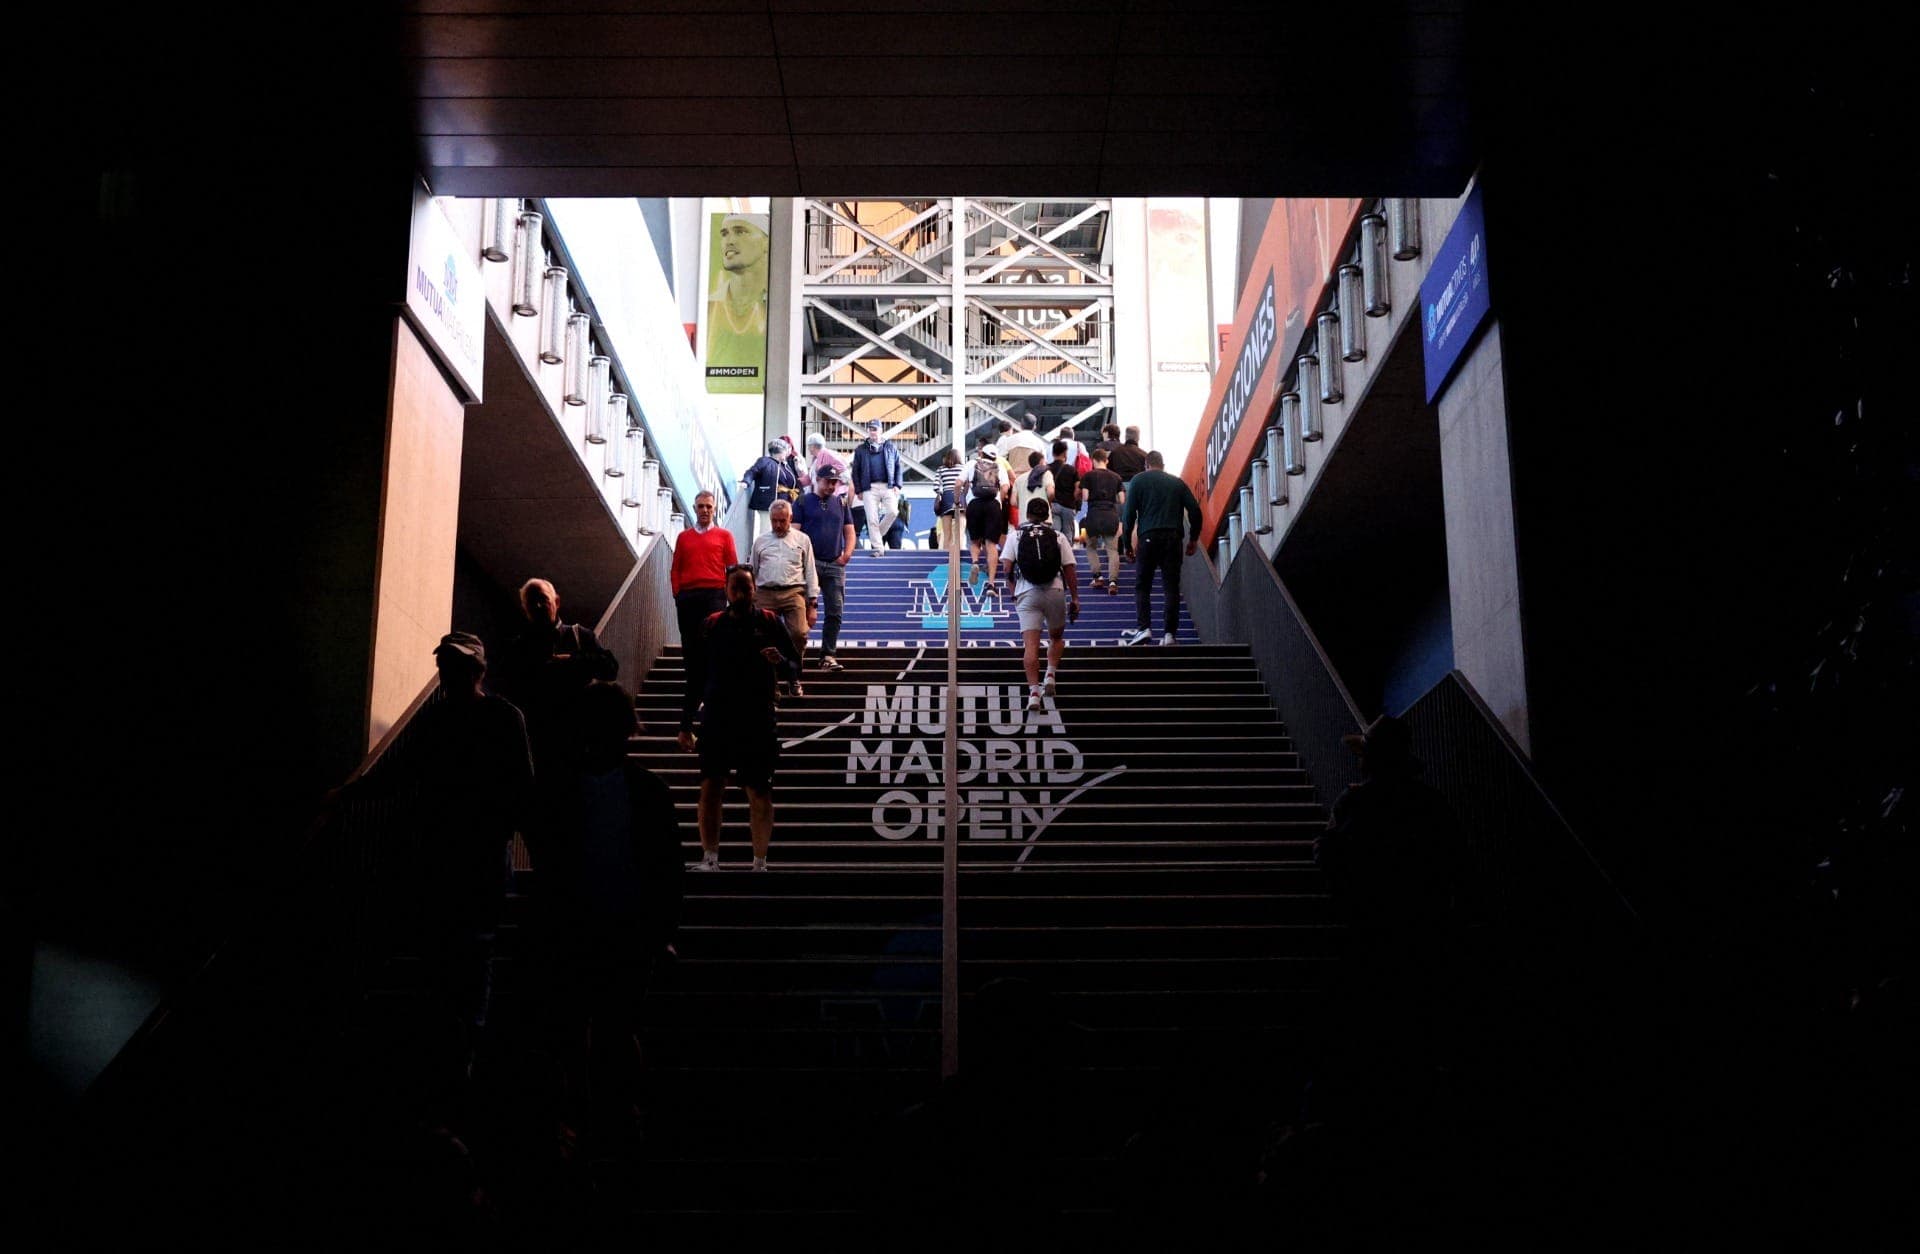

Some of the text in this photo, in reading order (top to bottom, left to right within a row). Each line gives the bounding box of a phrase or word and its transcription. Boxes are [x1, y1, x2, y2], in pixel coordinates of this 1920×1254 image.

[709, 368, 756, 377] #MMOPEN
[1206, 284, 1275, 490] PULSACIONES
[860, 685, 1067, 734] MUTUA
[846, 740, 1084, 784] MADRID
[871, 790, 1051, 840] OPEN
